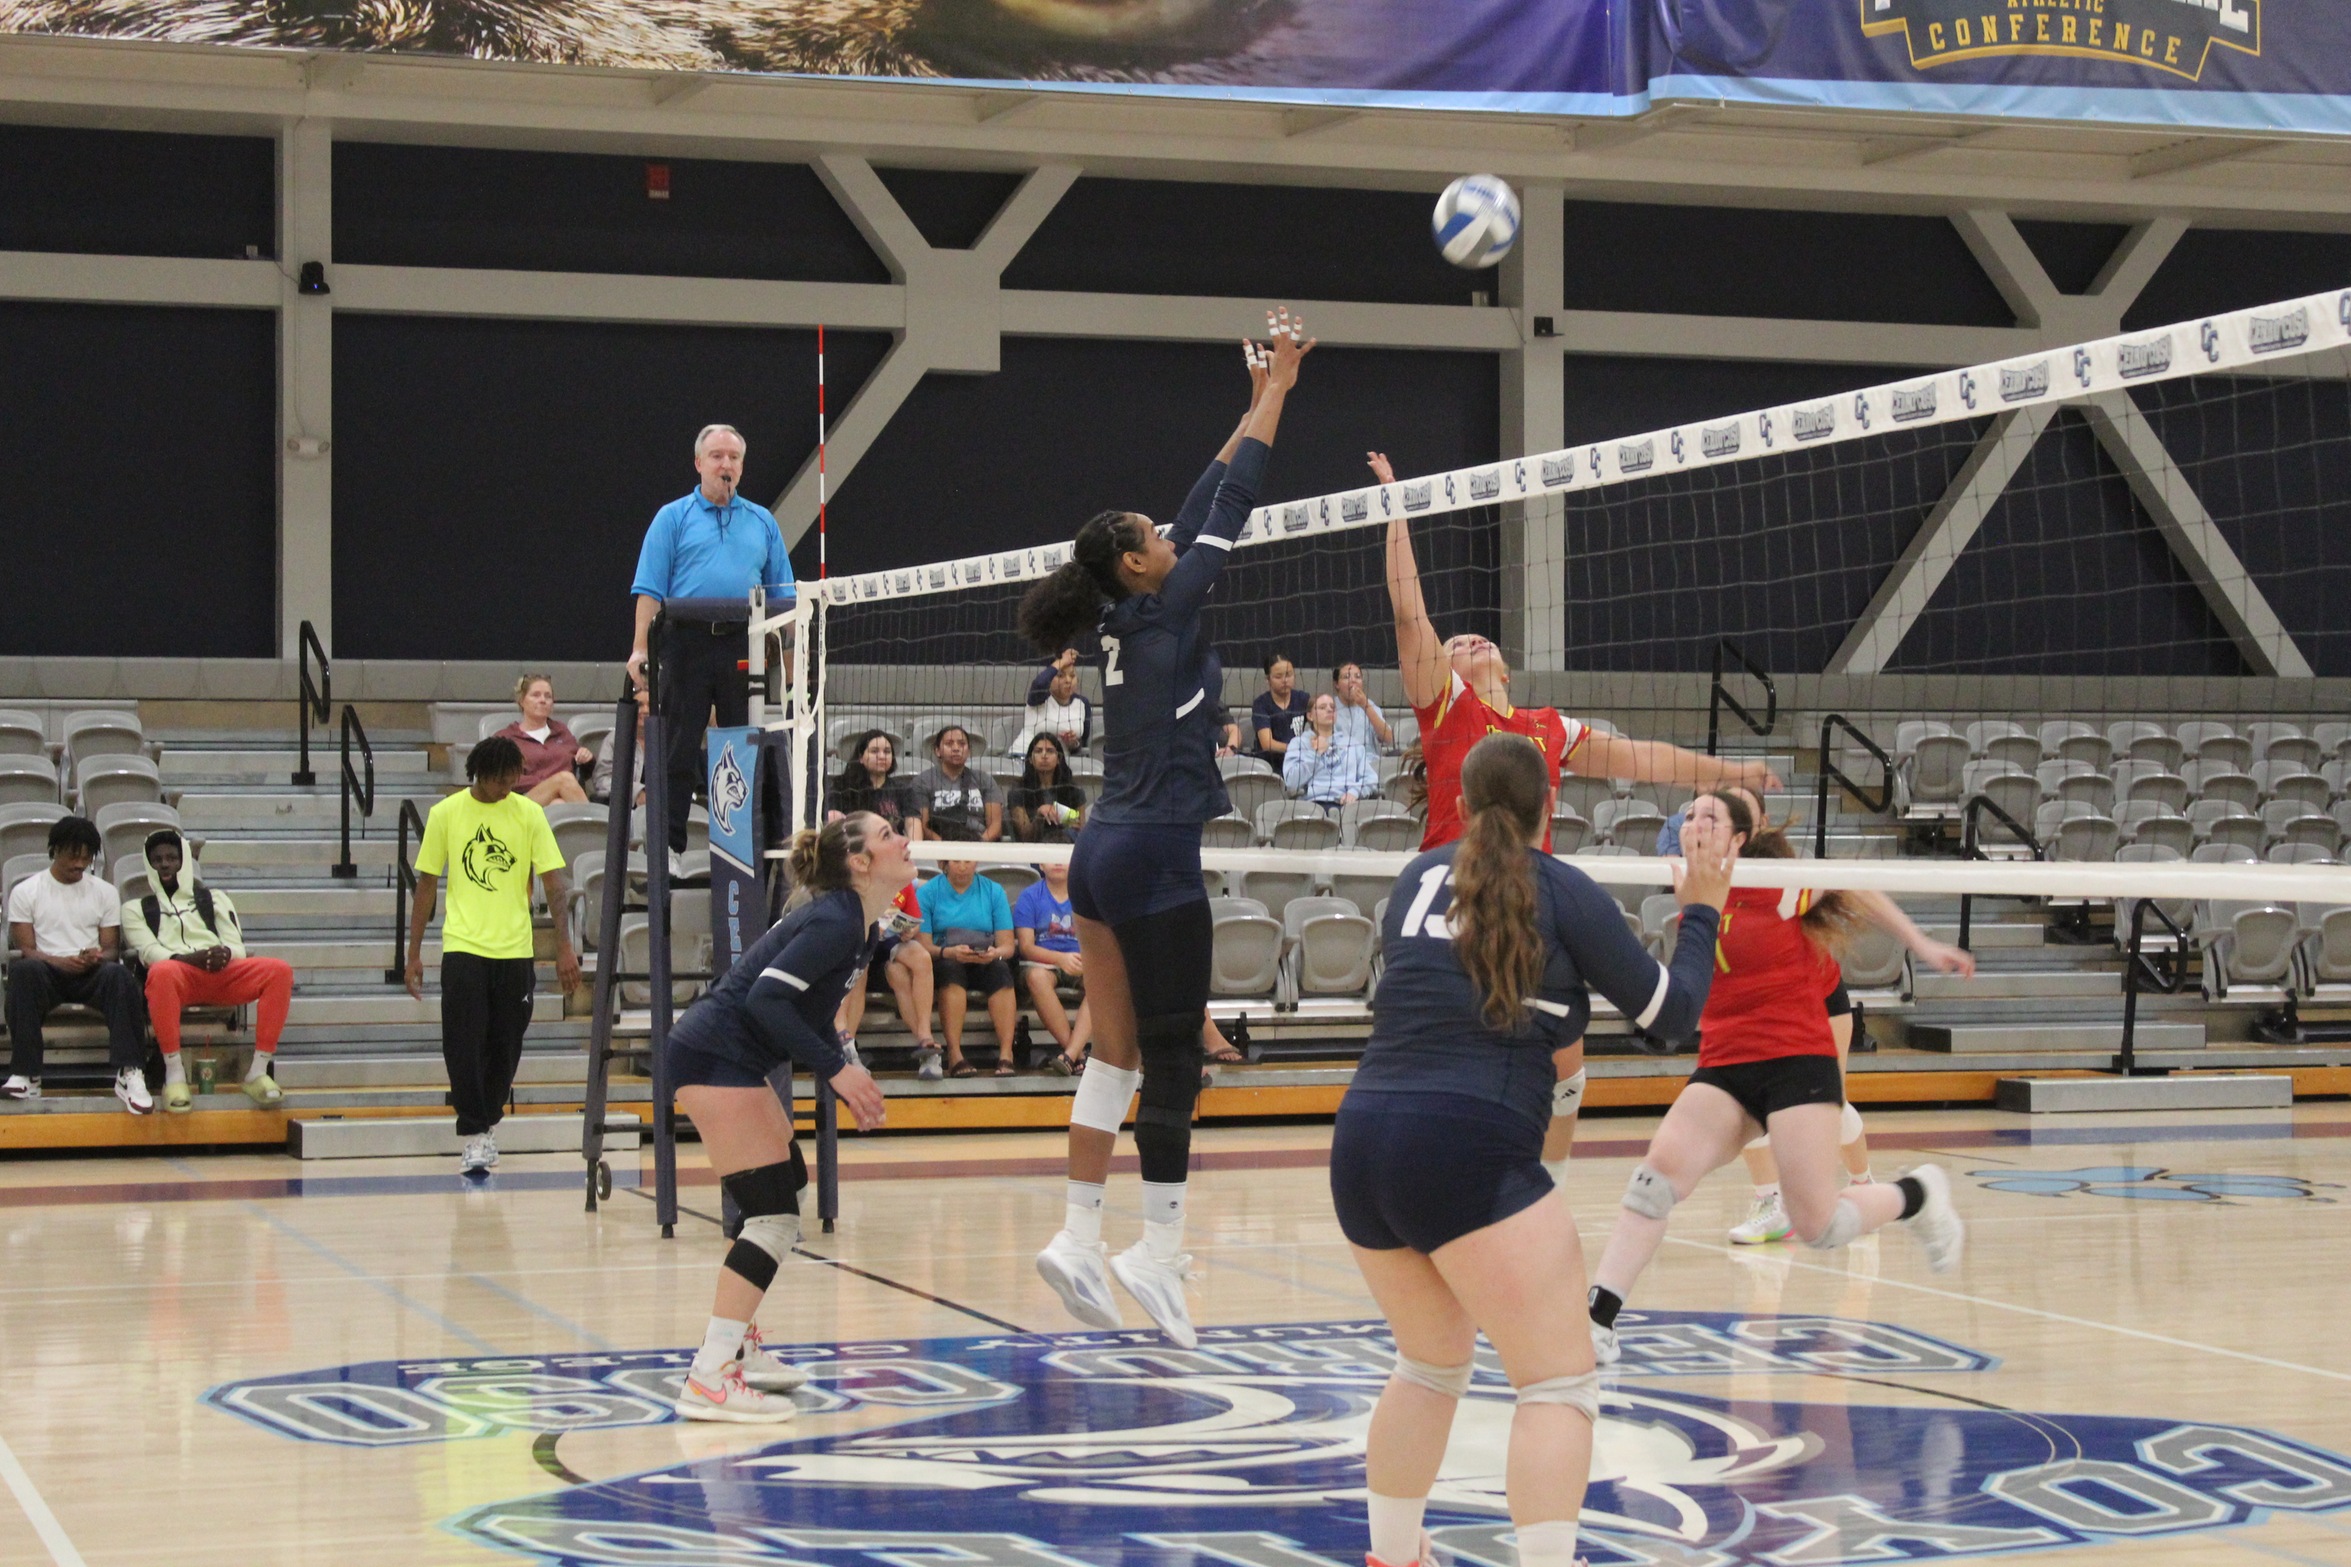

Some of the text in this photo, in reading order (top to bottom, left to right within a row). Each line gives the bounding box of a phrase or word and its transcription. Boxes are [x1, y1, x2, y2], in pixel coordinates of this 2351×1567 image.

[1928, 14, 2181, 64] CONFERENCE
[1101, 634, 1124, 686] 2
[399, 1343, 910, 1374] COLEGE
[1042, 1317, 1985, 1375] CERO
